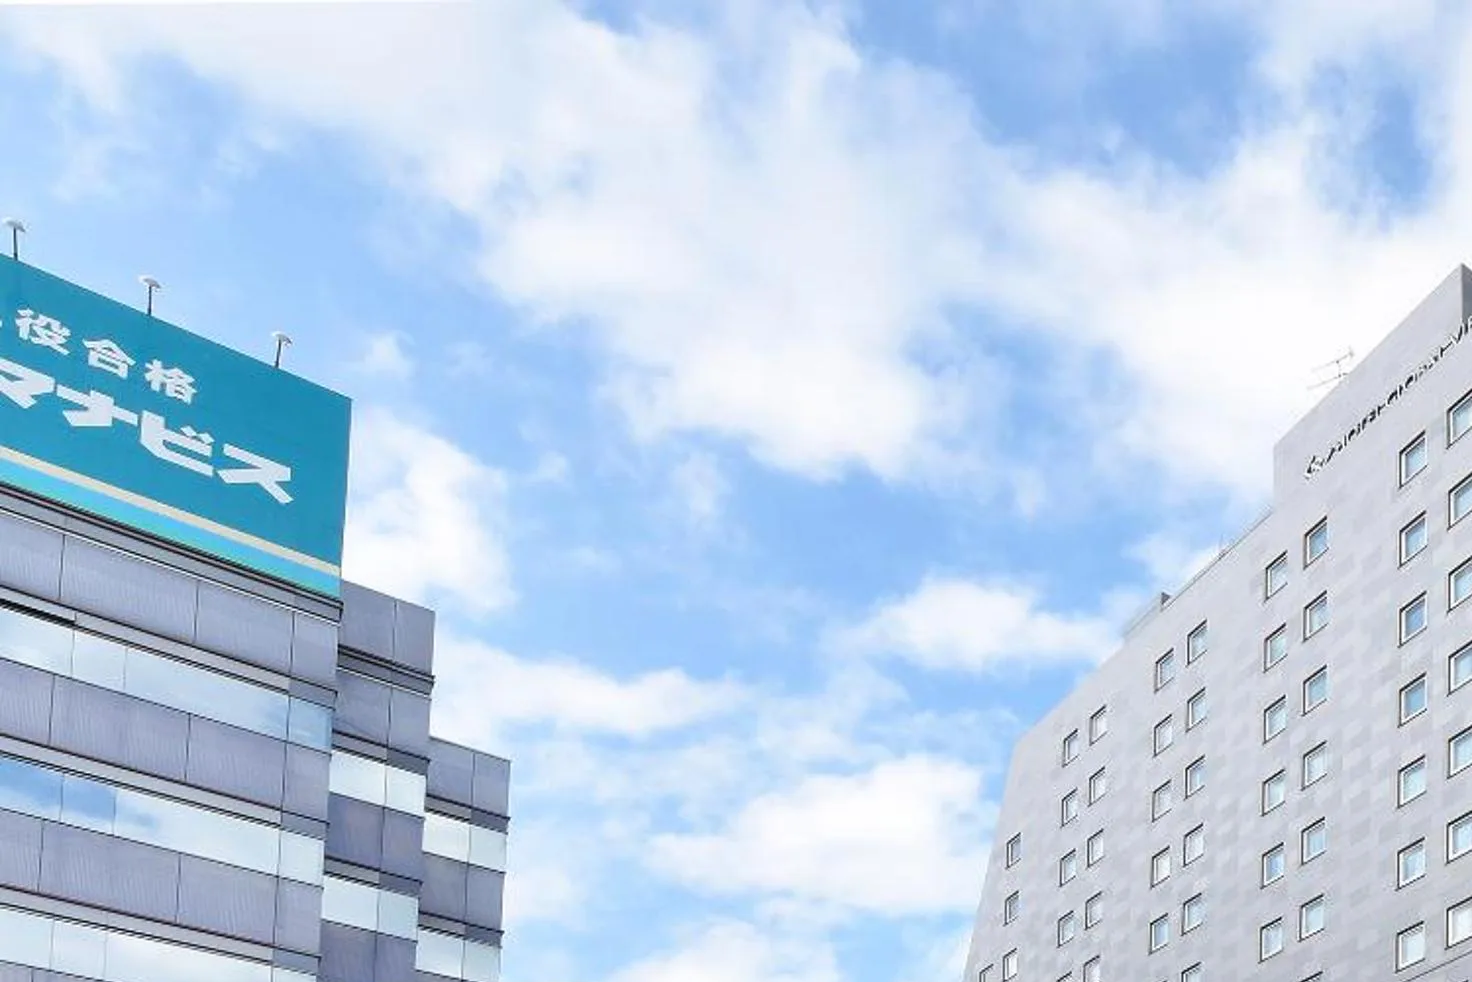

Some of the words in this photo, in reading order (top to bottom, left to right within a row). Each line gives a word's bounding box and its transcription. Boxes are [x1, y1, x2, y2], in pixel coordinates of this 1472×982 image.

[0, 308, 198, 405] 役合格
[0, 357, 294, 505] マナビス
